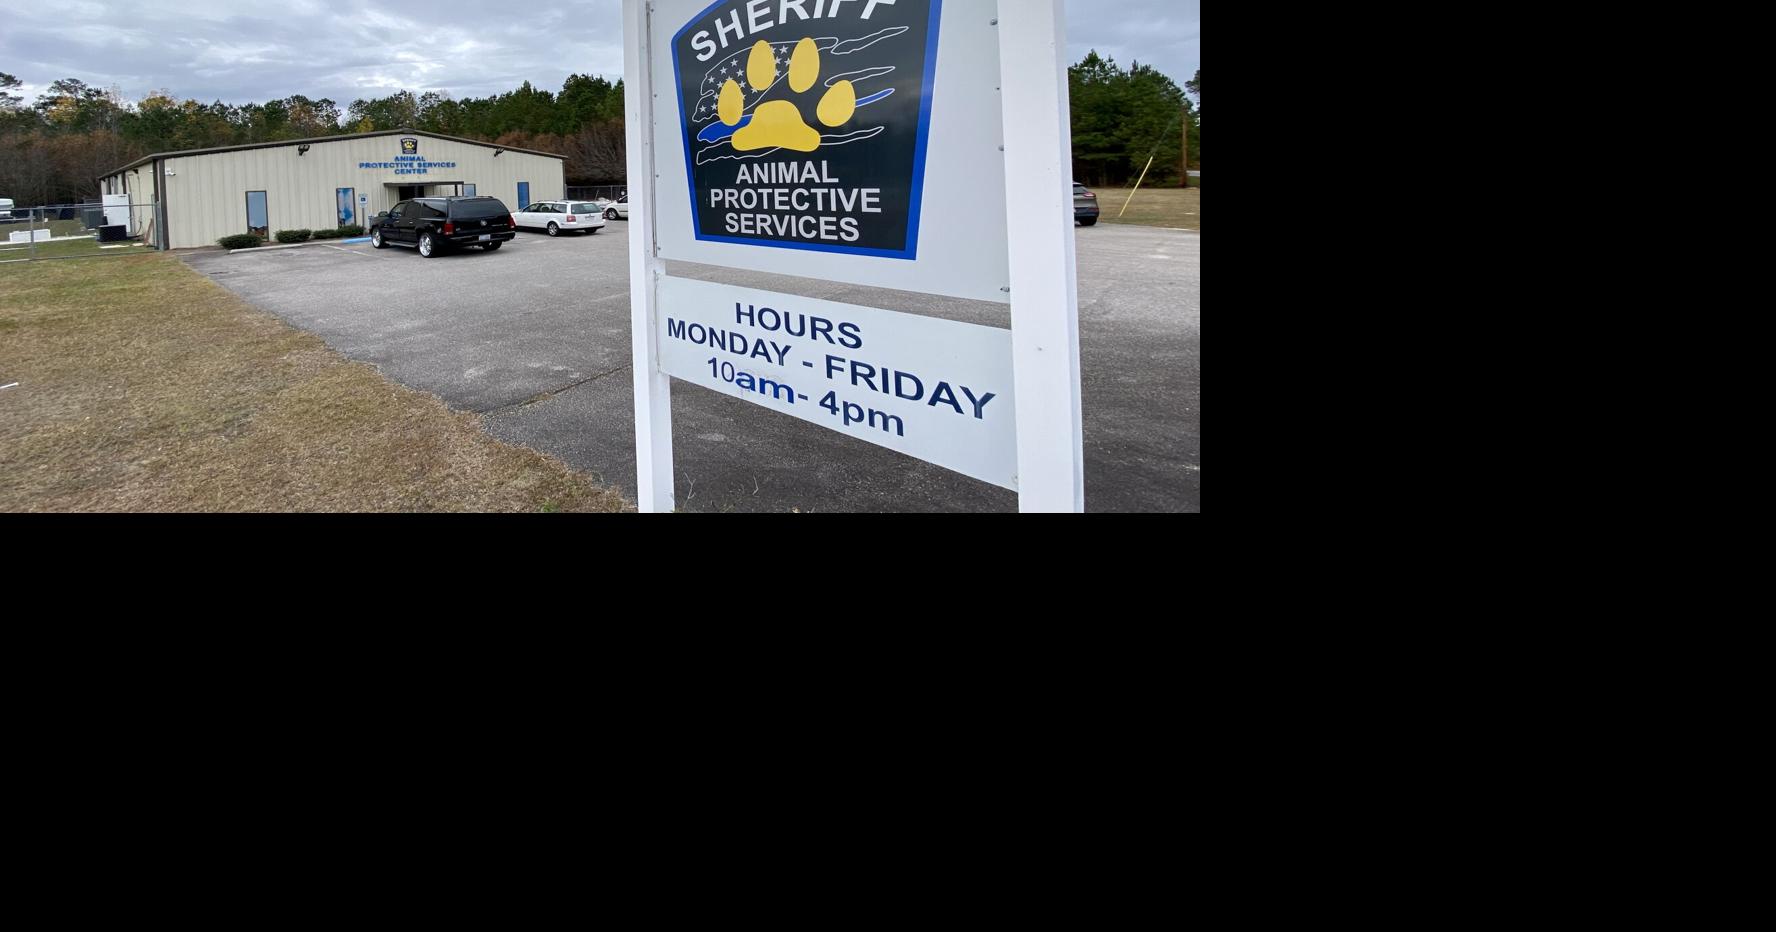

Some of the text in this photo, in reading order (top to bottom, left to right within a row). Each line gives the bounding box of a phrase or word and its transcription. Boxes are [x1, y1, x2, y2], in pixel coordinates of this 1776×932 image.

[735, 160, 839, 184] ANIMAL
[710, 188, 882, 213] PROTECTIVE
[725, 212, 860, 242] SERVICES
[735, 302, 863, 350] HOURS
[667, 317, 792, 367] MONDAY
[825, 354, 997, 420] FRIDAY
[818, 390, 905, 437] 4pm
